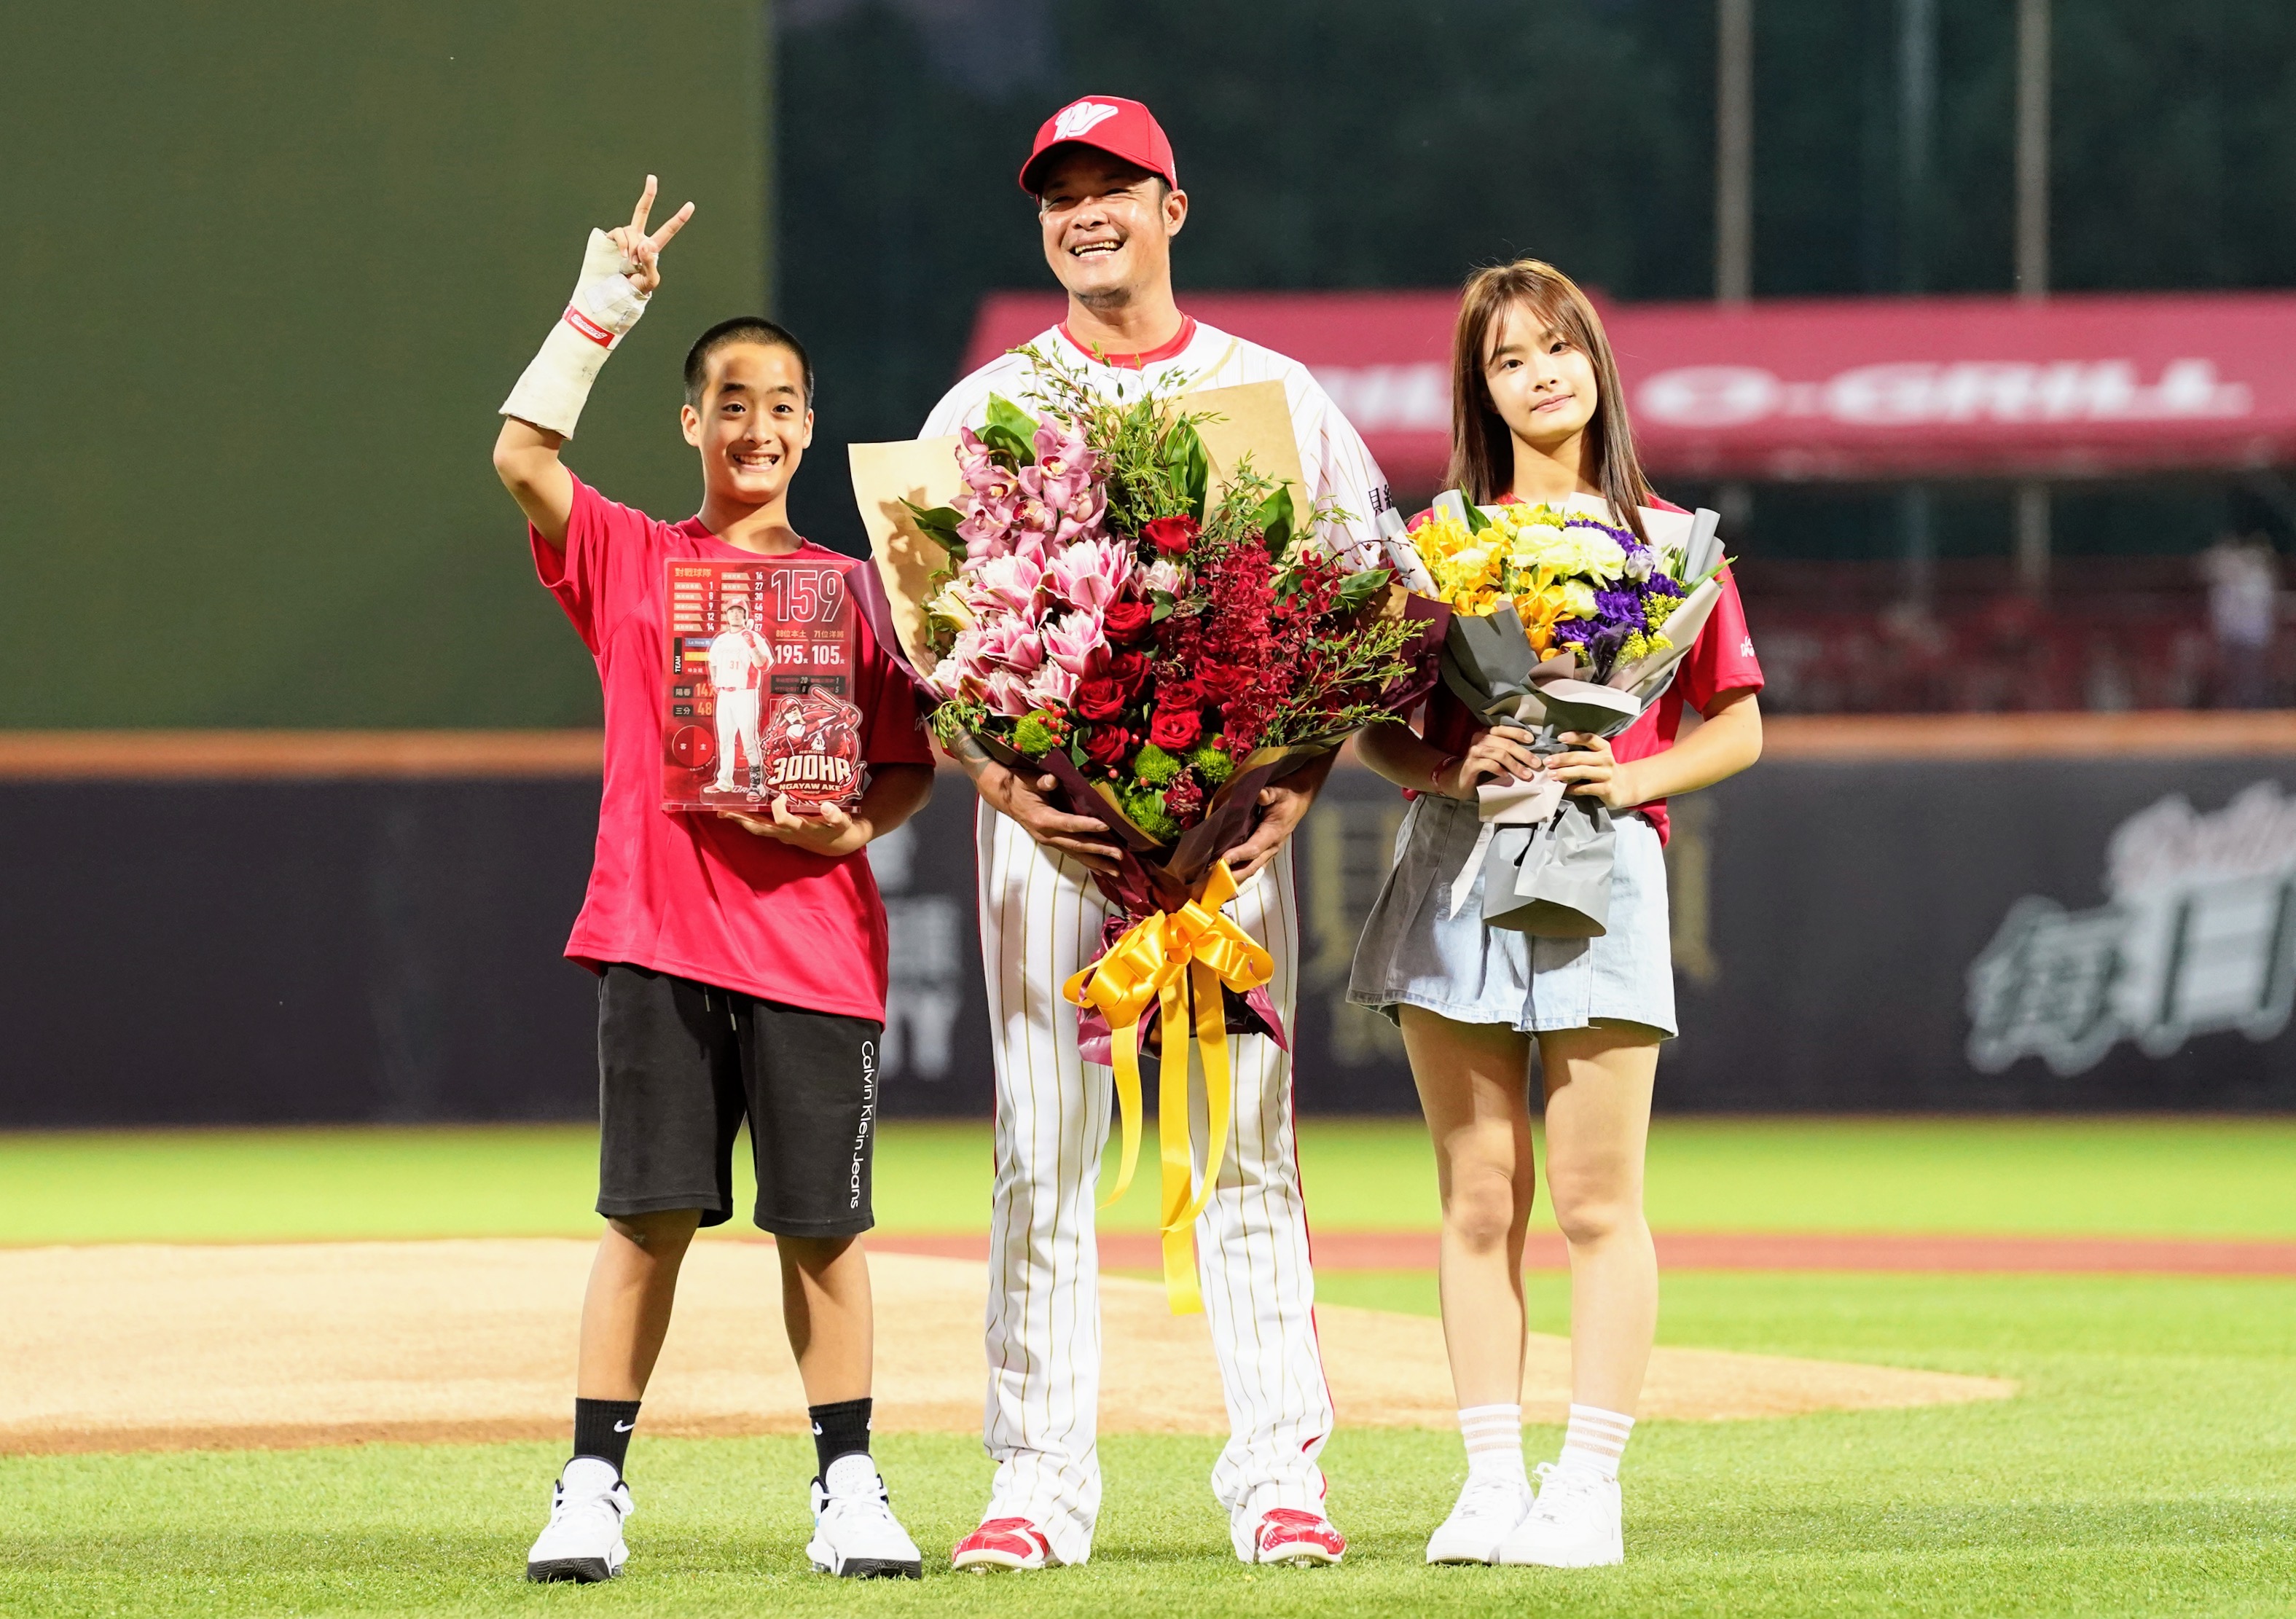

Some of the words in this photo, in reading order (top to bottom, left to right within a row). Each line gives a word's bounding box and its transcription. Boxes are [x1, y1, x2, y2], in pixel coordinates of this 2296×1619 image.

[755, 572, 763, 580] 16
[709, 581, 713, 589] 1
[755, 582, 763, 590] 27
[708, 592, 713, 600] 8
[754, 592, 763, 600] 30
[771, 569, 845, 622] 159
[708, 603, 713, 611] 9
[754, 603, 763, 611] 46
[707, 613, 714, 621] 12
[754, 614, 763, 622] 50
[707, 623, 714, 631] 14
[775, 645, 803, 665] 195
[812, 645, 840, 665] 105
[729, 660, 739, 670] 31
[675, 707, 691, 715] 三分
[697, 702, 712, 716] 48
[767, 755, 852, 785] 300HR
[778, 783, 820, 791] NGAYAW
[861, 1040, 874, 1100] Calvin
[855, 1104, 873, 1150] Klein
[850, 1152, 864, 1209] Jeans
